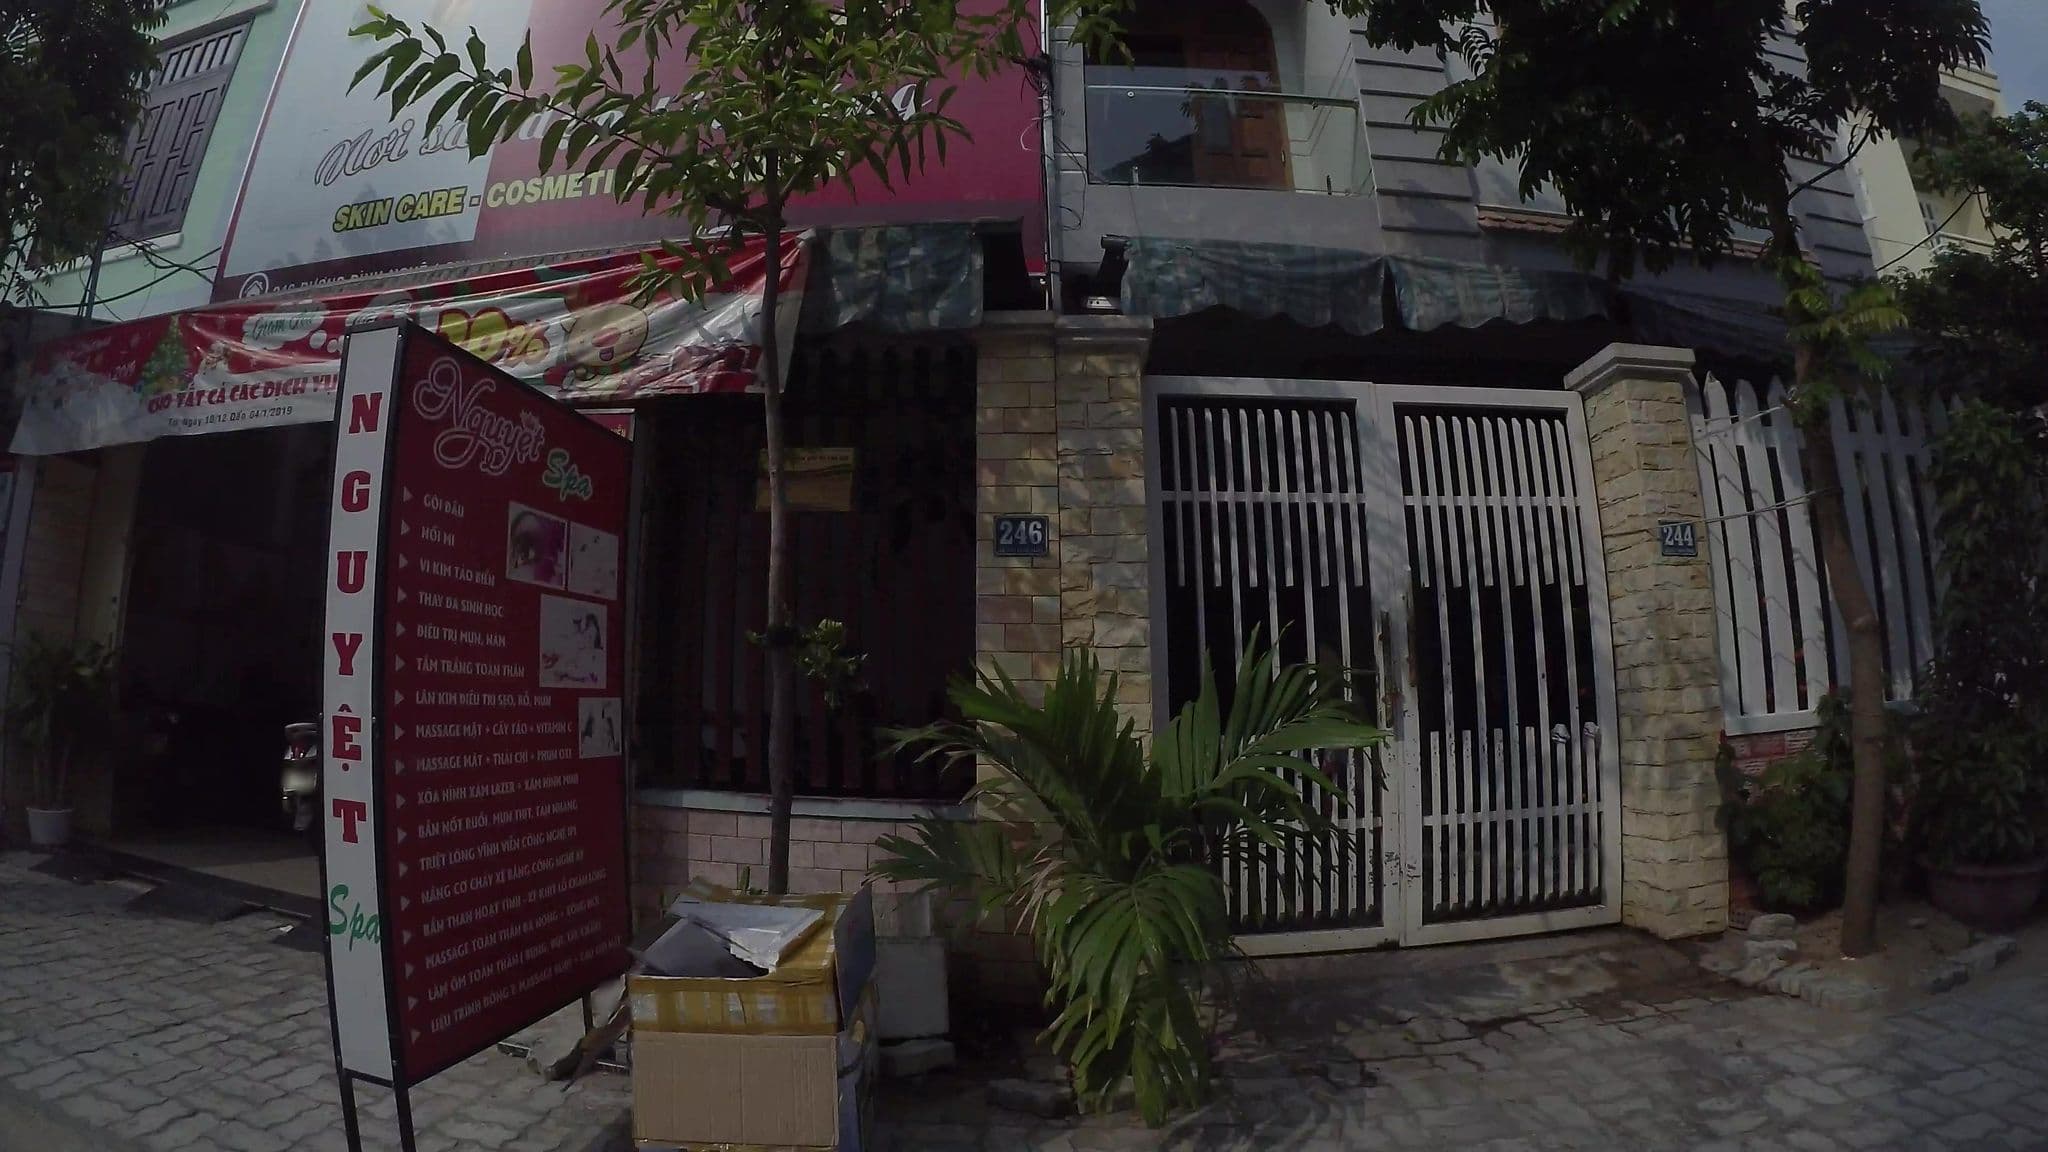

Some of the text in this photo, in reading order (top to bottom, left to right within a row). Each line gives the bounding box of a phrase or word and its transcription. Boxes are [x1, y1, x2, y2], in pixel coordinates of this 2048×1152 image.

[333, 197, 393, 233] SKIN
[395, 186, 468, 223] CARE
[541, 447, 593, 502] Spa
[1000, 520, 1042, 545] 246
[1663, 525, 1694, 546] 244
[418, 591, 444, 608] THAY
[461, 599, 483, 615] SINH
[439, 690, 457, 706] KIM
[415, 723, 461, 740] MASSAGE
[416, 755, 461, 772] MASSAGE
[491, 780, 516, 797] LAZER
[328, 884, 383, 952] Spa
[425, 944, 469, 970] MASSAGE
